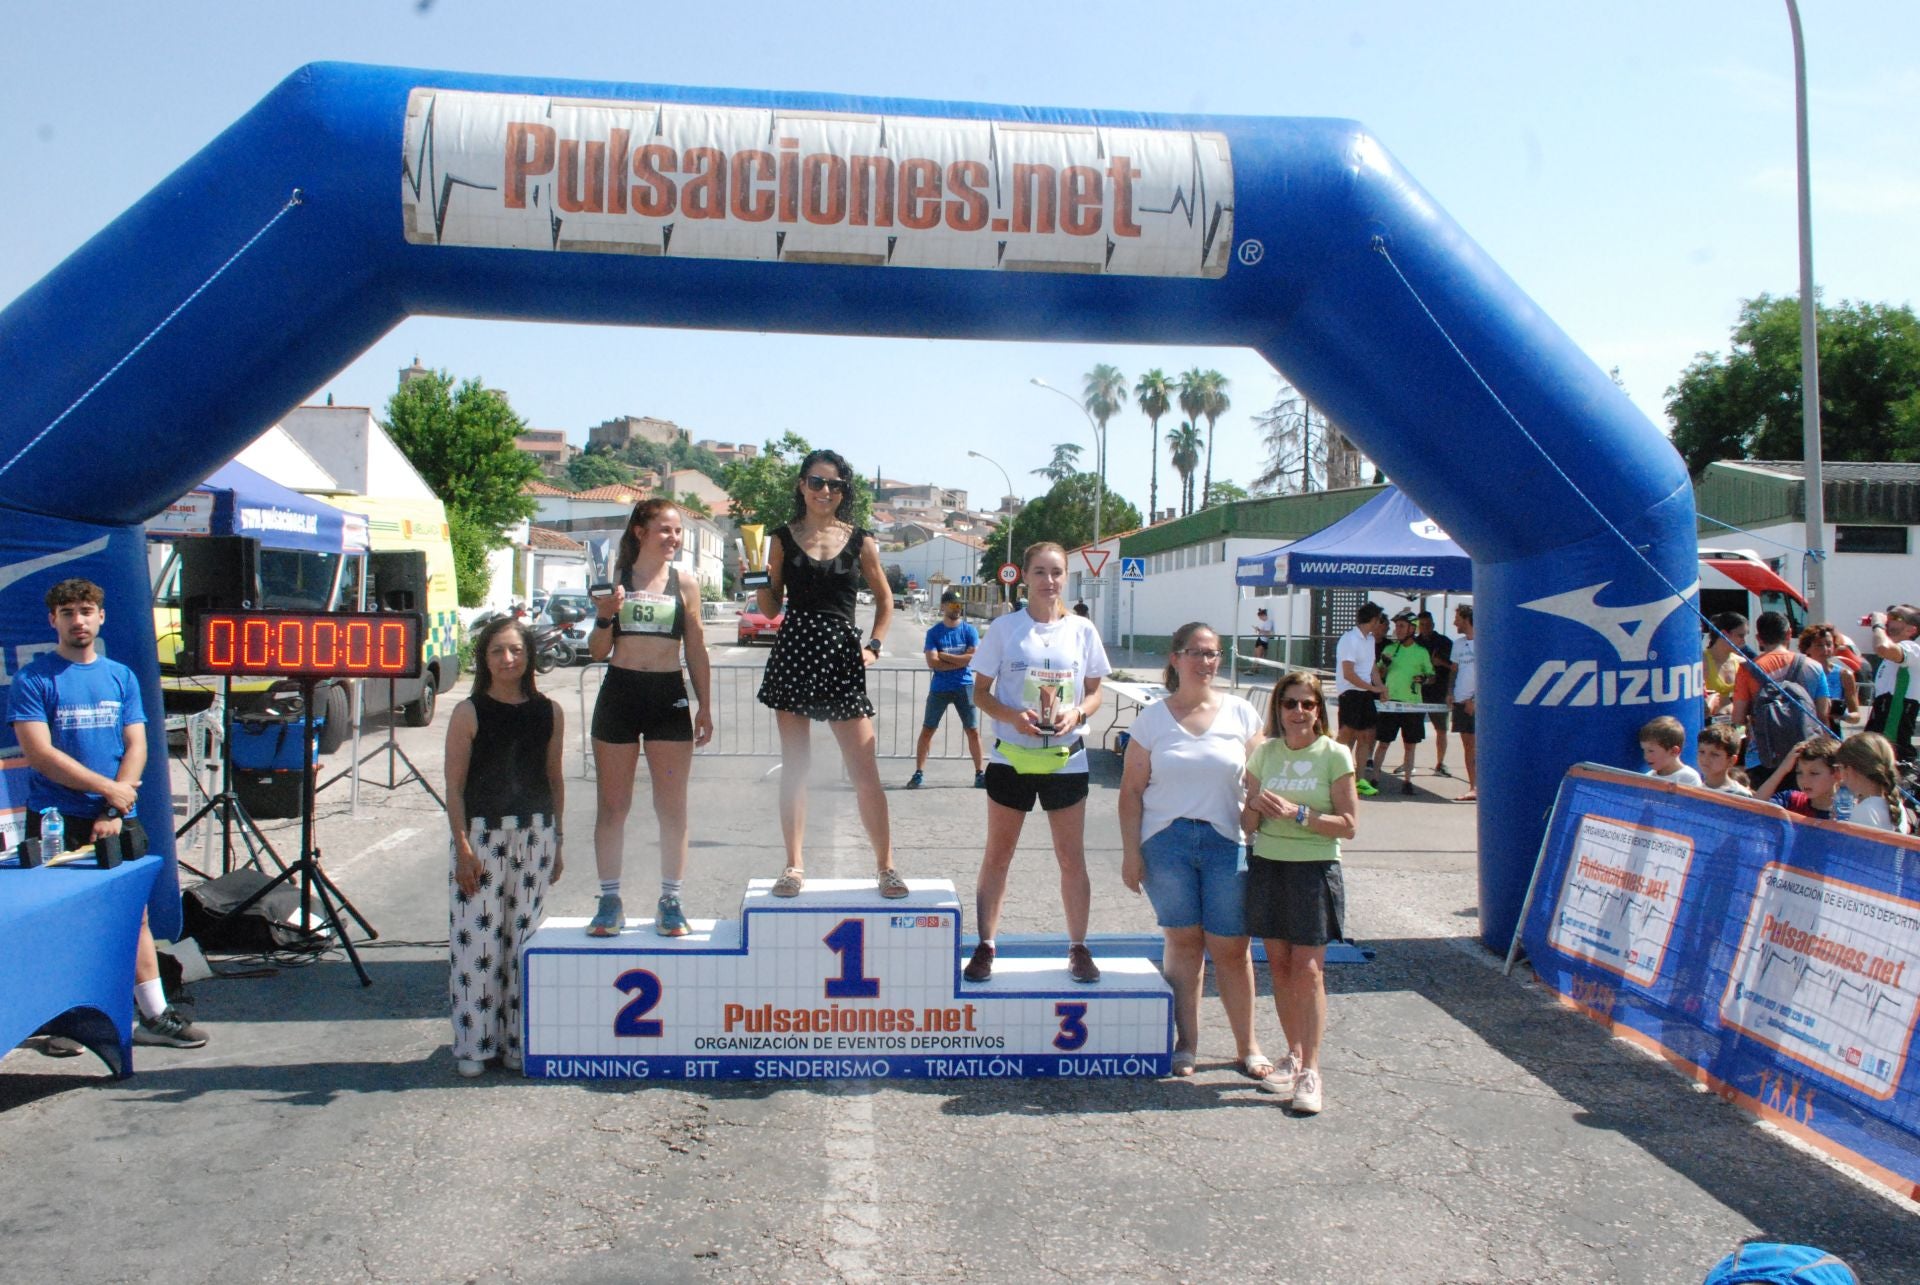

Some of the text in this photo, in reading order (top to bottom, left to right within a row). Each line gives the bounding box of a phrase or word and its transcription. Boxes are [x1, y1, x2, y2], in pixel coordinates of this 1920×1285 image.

[504, 121, 1142, 237] Pulsaciones.net
[1003, 570, 1015, 578] 30
[1300, 561, 1435, 577] WWW.PROTEGEBIKE.ES
[632, 604, 655, 622] 63
[209, 619, 405, 668] 00:00:00
[1266, 777, 1319, 791] GREEN
[1577, 855, 1669, 902] Pulsaciones.net
[1765, 875, 1822, 901] ORGANIZACIÓN
[1823, 893, 1835, 906] DE
[1837, 896, 1875, 918] EVENTOS
[824, 918, 880, 998] 1
[1760, 912, 1906, 989] Pulsaciones.net
[613, 968, 664, 1038] 2
[724, 1003, 977, 1033] Pulsaciones.net
[694, 1034, 1005, 1050] ORGANIZACIÓN DE EVENTOS DEPORTIVOS
[1052, 1002, 1089, 1051] 3
[545, 1059, 650, 1078] RUNNING
[684, 1060, 720, 1078] BTT
[754, 1059, 890, 1078] SENDERISMO
[924, 1055, 1023, 1077] TRIATLÓN
[1058, 1054, 1157, 1076] DUATLÓN
